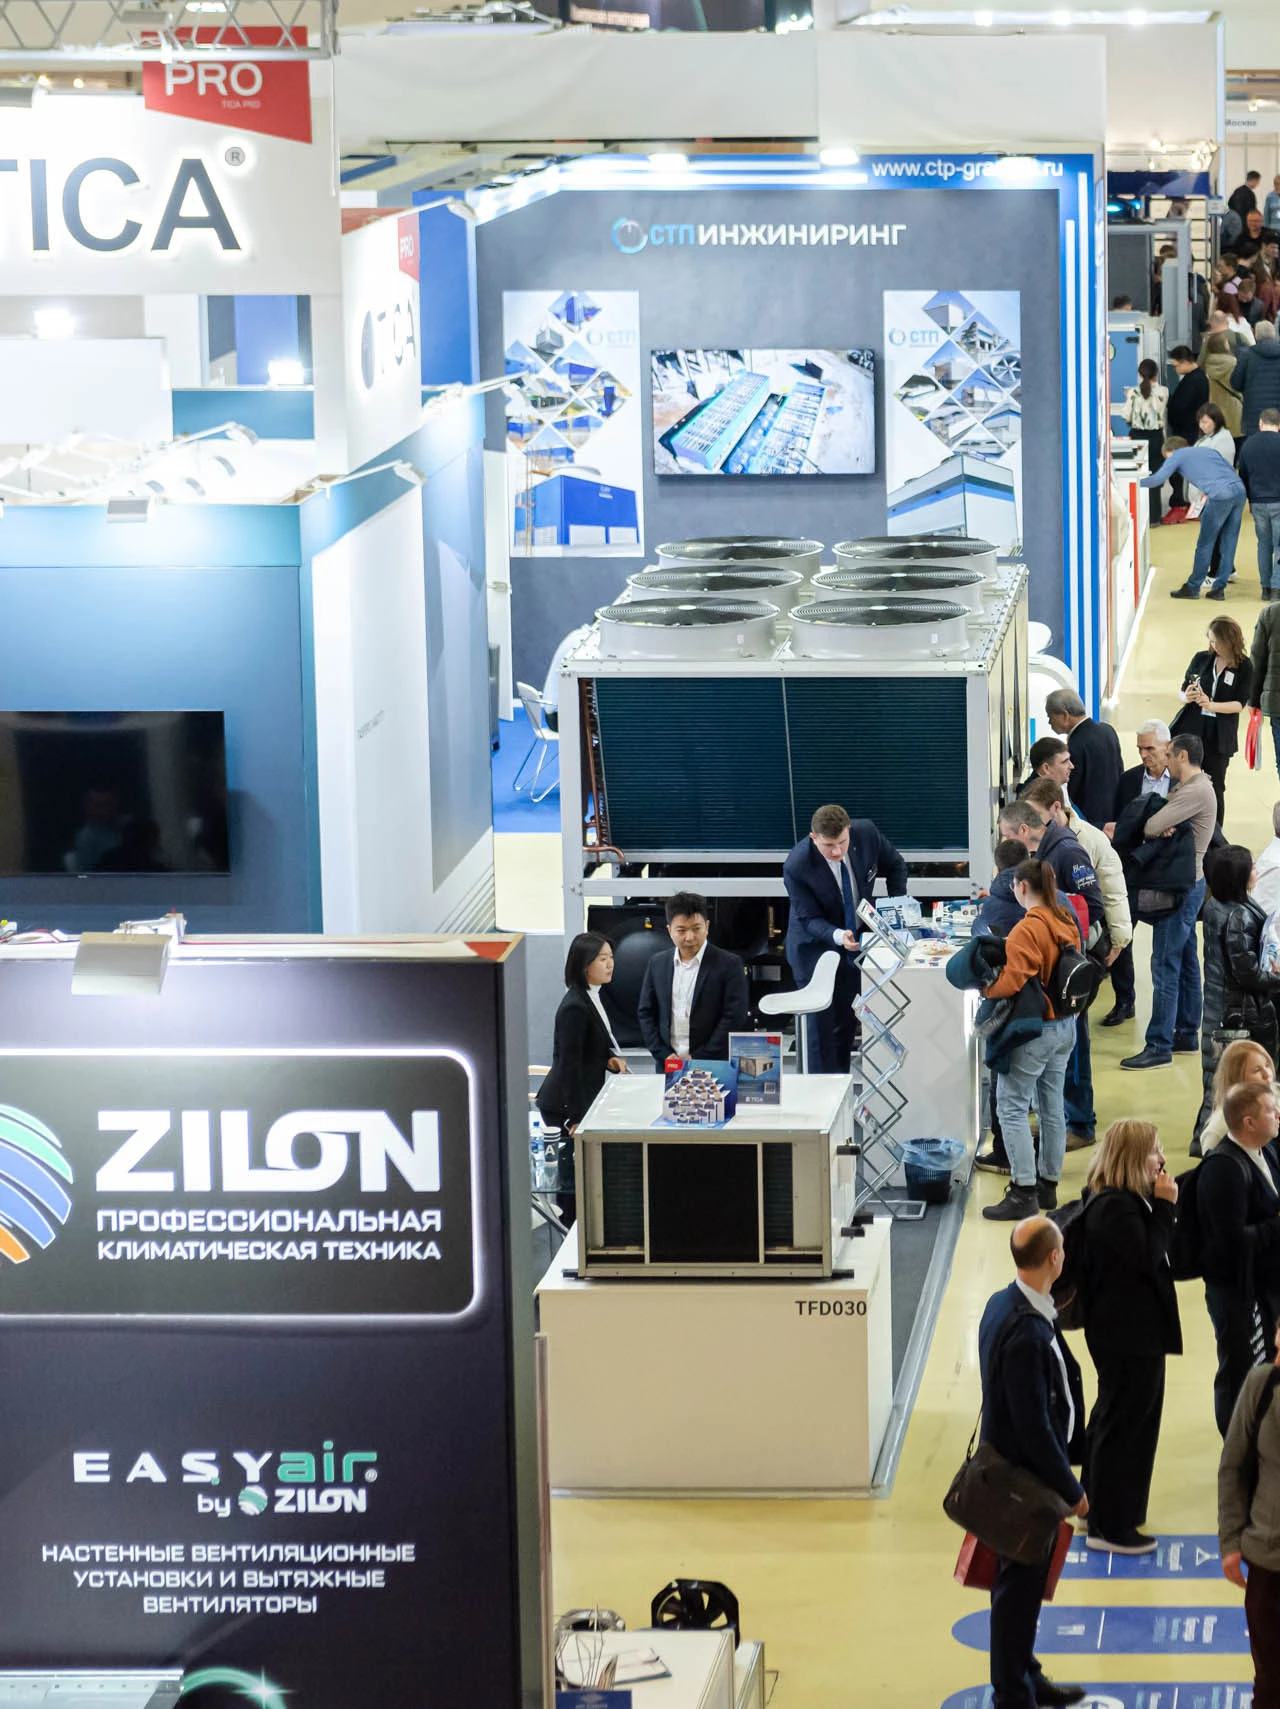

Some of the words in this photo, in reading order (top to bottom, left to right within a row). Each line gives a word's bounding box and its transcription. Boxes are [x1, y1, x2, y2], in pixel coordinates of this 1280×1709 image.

[165, 62, 263, 97] PRO
[650, 225, 694, 245] СТП
[699, 225, 906, 246] ИНЖИНИРИНГ
[96, 1110, 441, 1192] ZILON
[96, 1209, 442, 1233] ПРОФЕССИОНАЛЬНАЯ
[97, 1241, 317, 1261] КЛИМАТИЧЕСКАЯ
[323, 1241, 442, 1261] ТЕХНИКА
[794, 1300, 868, 1317] TFD030
[197, 1494, 231, 1518] by
[274, 1487, 367, 1514] ZILON
[42, 1544, 185, 1563] НАСТЕННЫЕ
[191, 1544, 416, 1564] ВЕНТИЛЯЦИОННЫЕ
[74, 1570, 213, 1589] УСТАНОВКИ
[220, 1570, 237, 1588] И
[243, 1570, 386, 1589] ВЫТЯЖНЫЕ
[143, 1596, 317, 1615] ВЕНТИЛЯТОРЫ
